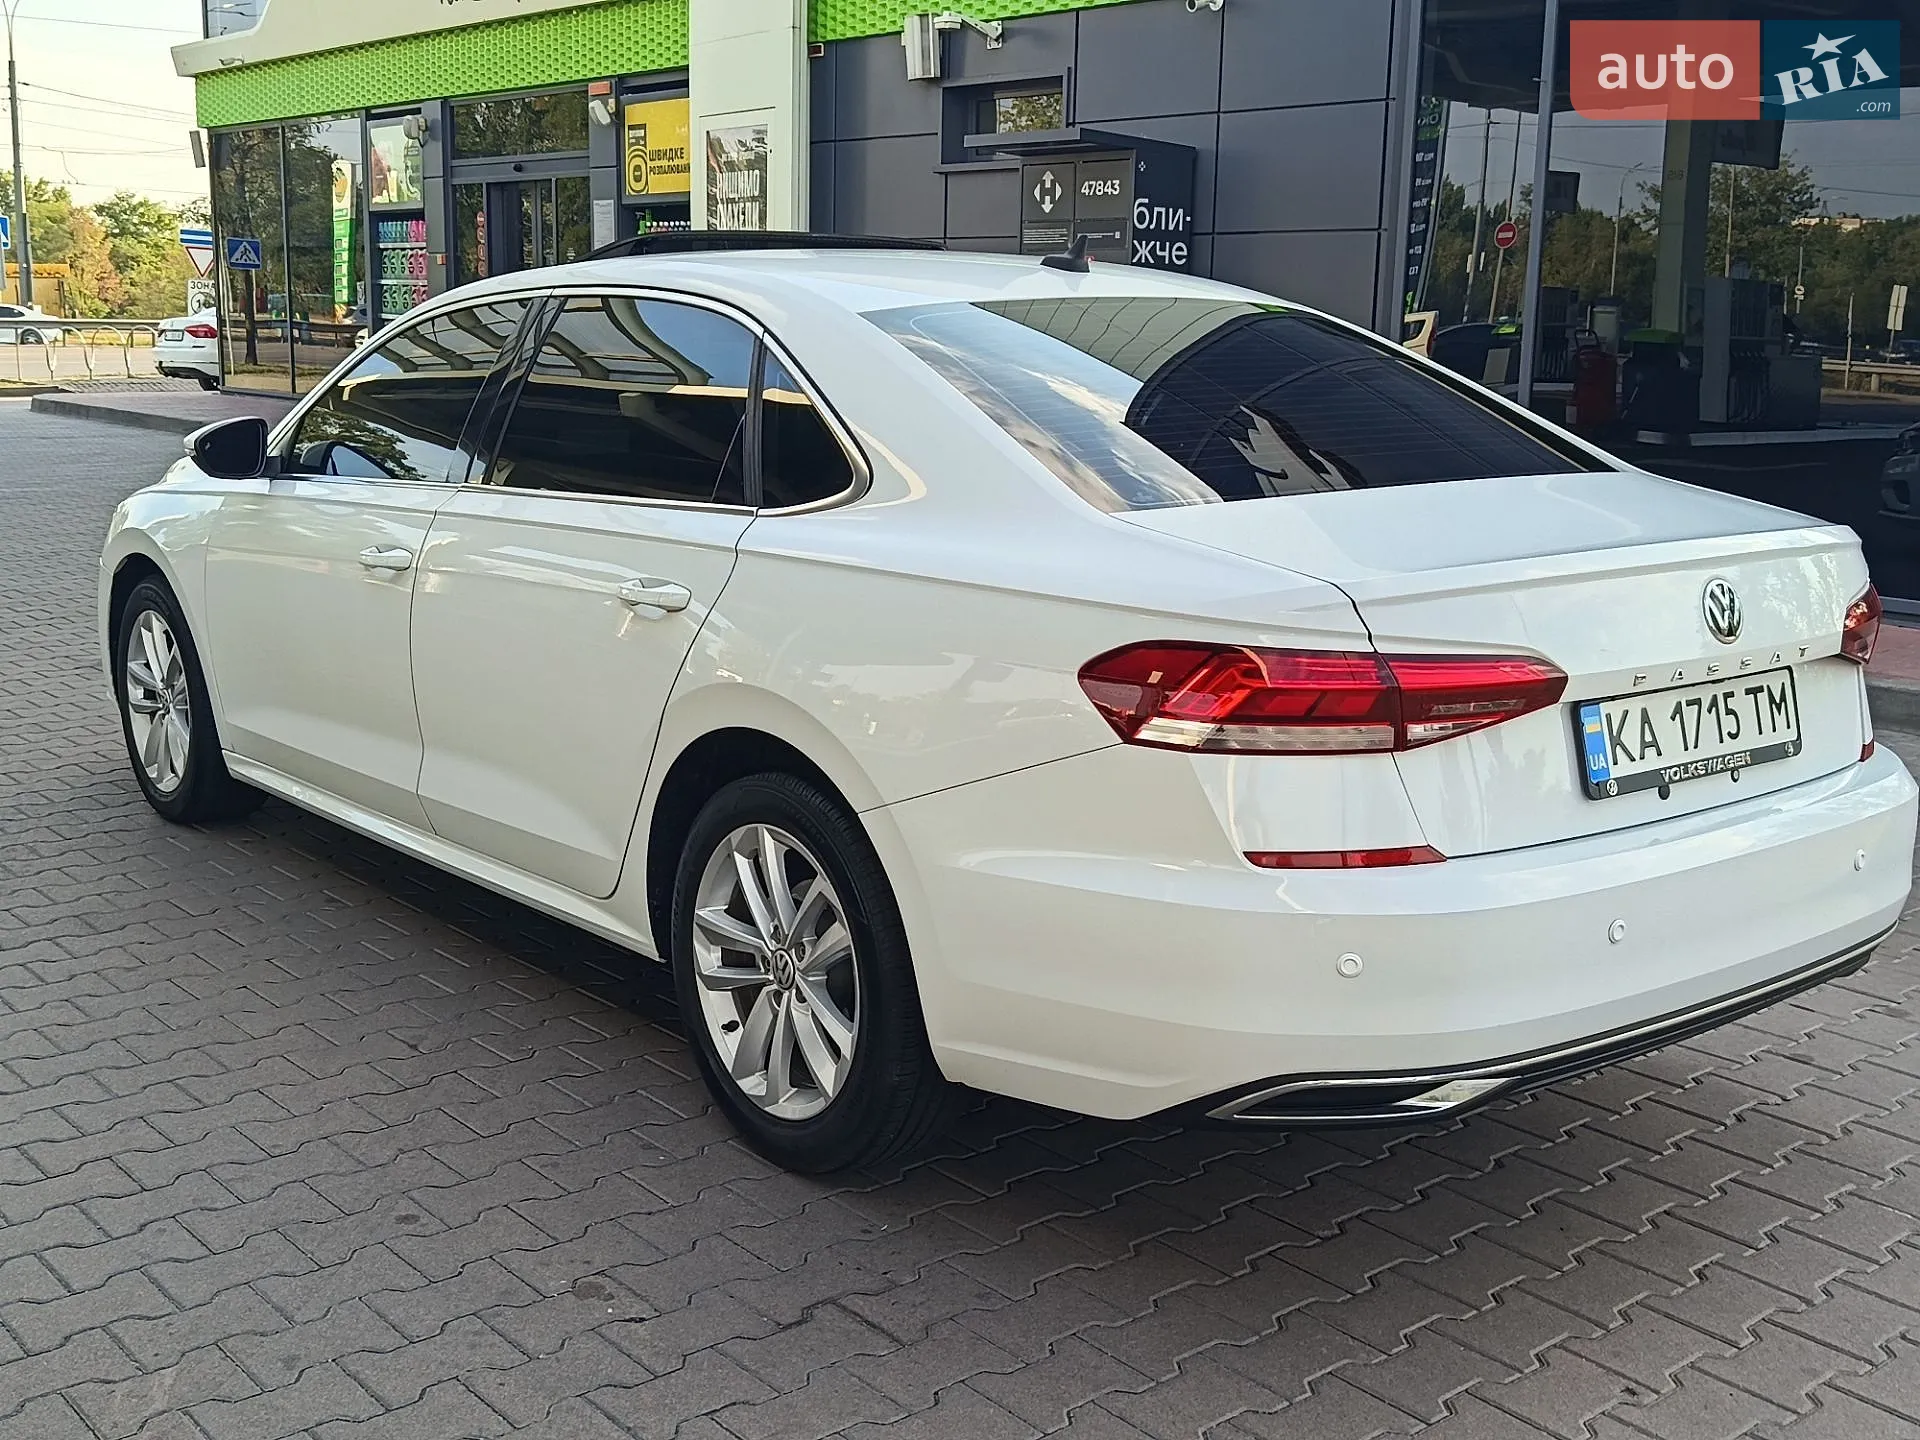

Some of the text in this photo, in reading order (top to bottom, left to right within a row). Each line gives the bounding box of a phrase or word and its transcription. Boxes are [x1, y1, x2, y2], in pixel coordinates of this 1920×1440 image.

[649, 147, 684, 162] ШВИДКЕ
[1080, 180, 1120, 196] 47843
[1133, 198, 1191, 232] бли-
[1132, 239, 1188, 265] жче
[1633, 645, 1808, 687] PASSAT
[1605, 682, 1790, 766] KA 1715 TM
[1589, 754, 1608, 771] UA
